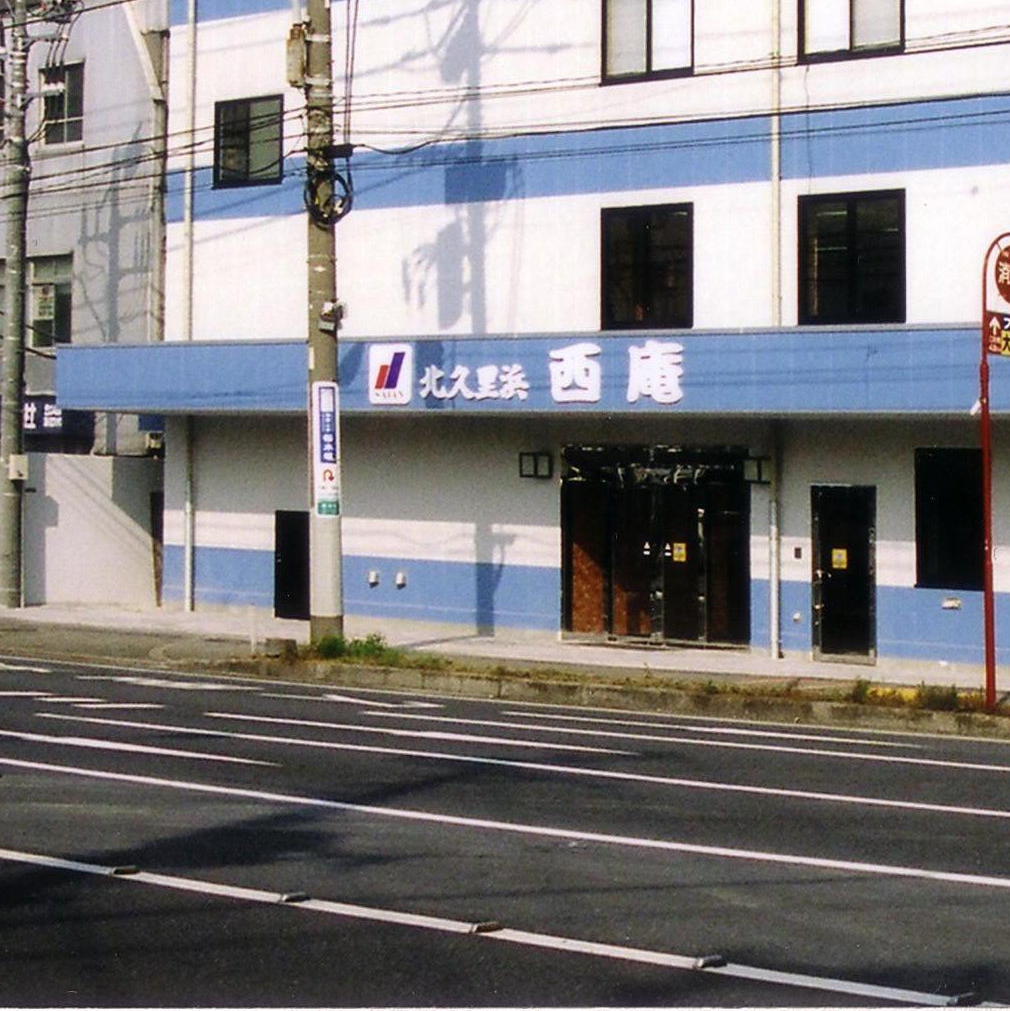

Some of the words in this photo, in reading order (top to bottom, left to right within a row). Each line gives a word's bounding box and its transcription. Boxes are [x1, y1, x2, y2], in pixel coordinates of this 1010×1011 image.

[419, 364, 530, 401] 北久里浜
[548, 341, 684, 405] 西庵
